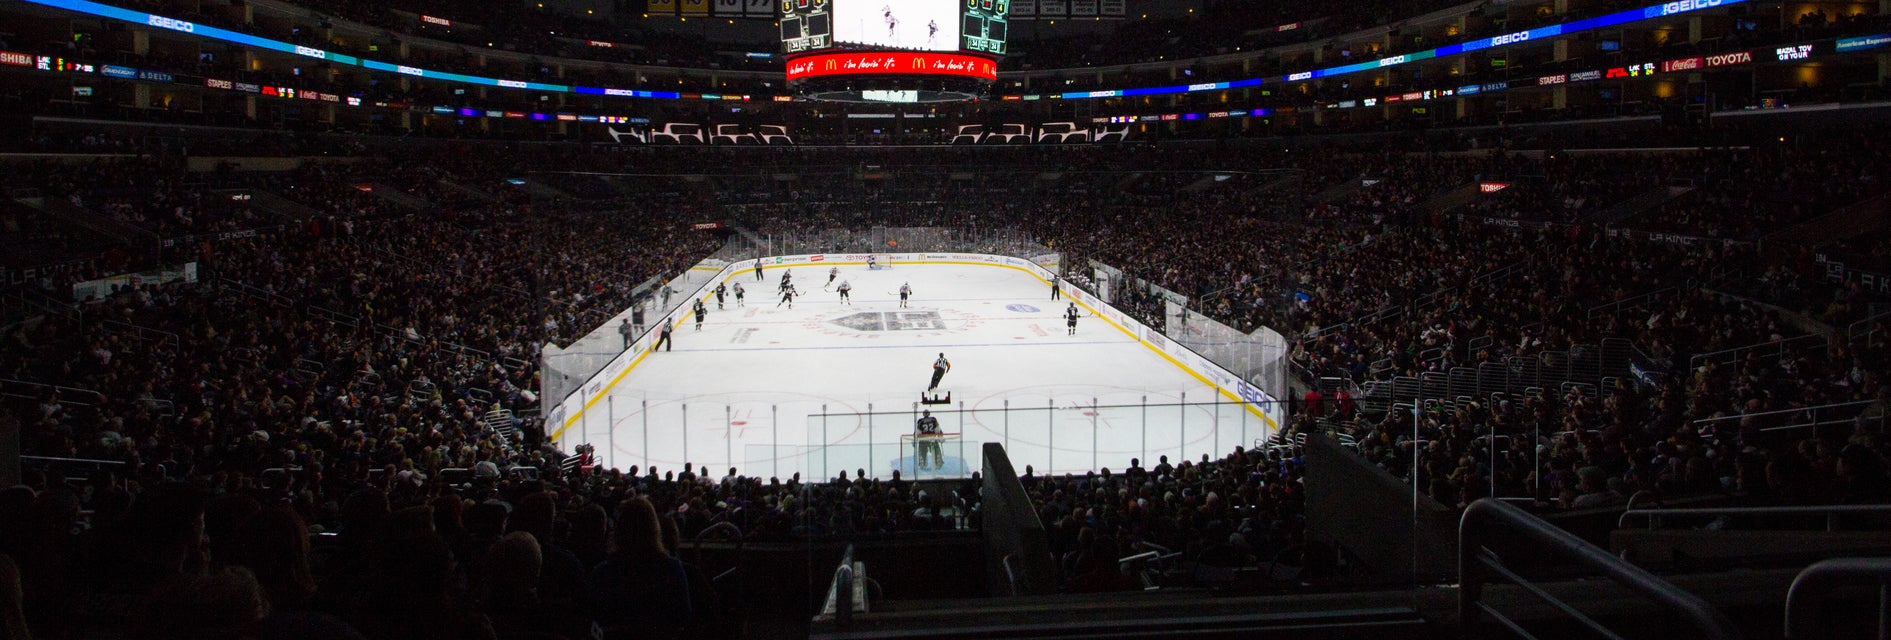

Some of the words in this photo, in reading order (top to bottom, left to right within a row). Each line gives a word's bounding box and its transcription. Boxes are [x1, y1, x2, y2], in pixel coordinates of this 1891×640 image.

[154, 15, 194, 33] GEICO
[423, 15, 450, 26] TOSHIBA
[1495, 31, 1529, 46] GEICO
[1381, 56, 1404, 67] GEICO
[1706, 52, 1751, 67] TOYOTA
[147, 72, 173, 81] DELTA
[1540, 75, 1566, 85] STAPLES
[208, 80, 232, 89] STAPLES
[695, 222, 718, 230] TOYOTA
[1237, 379, 1274, 414] GEICO
